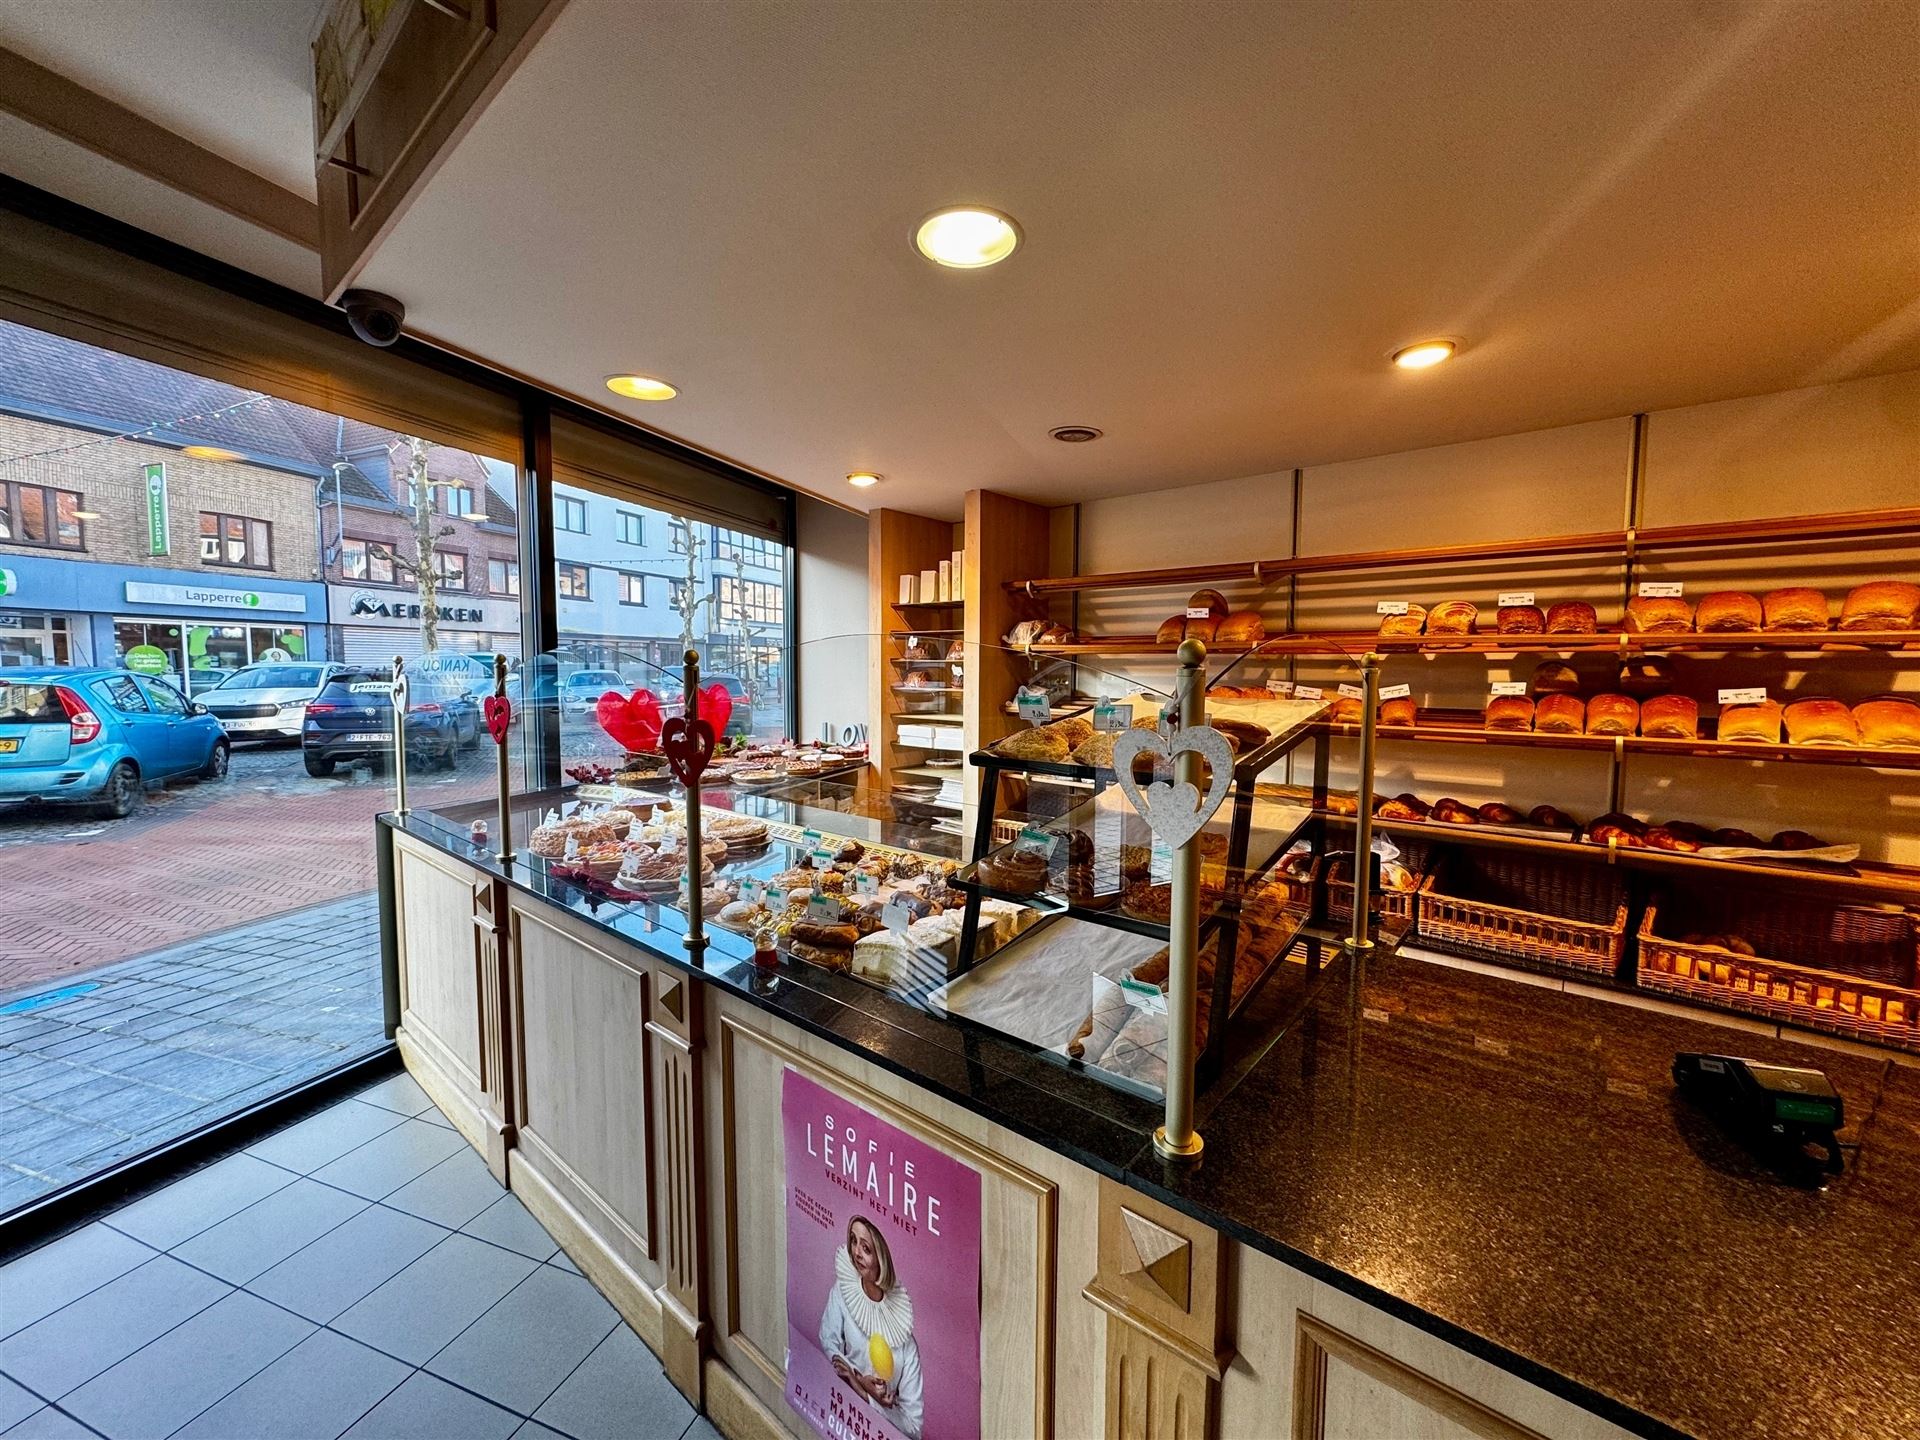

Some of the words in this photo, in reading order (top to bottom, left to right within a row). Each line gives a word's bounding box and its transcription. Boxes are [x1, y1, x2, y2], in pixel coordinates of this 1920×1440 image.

[154, 495, 162, 549] Lapperre
[186, 590, 242, 604] Lapperre
[352, 602, 483, 623] MERKEN
[825, 1114, 915, 1178] SOFIE
[807, 1123, 940, 1236] LEMAIRE
[825, 1169, 864, 1201] VERZINT
[869, 1197, 888, 1217] HET
[893, 1213, 918, 1237] NIET
[849, 1402, 871, 1430] MRT
